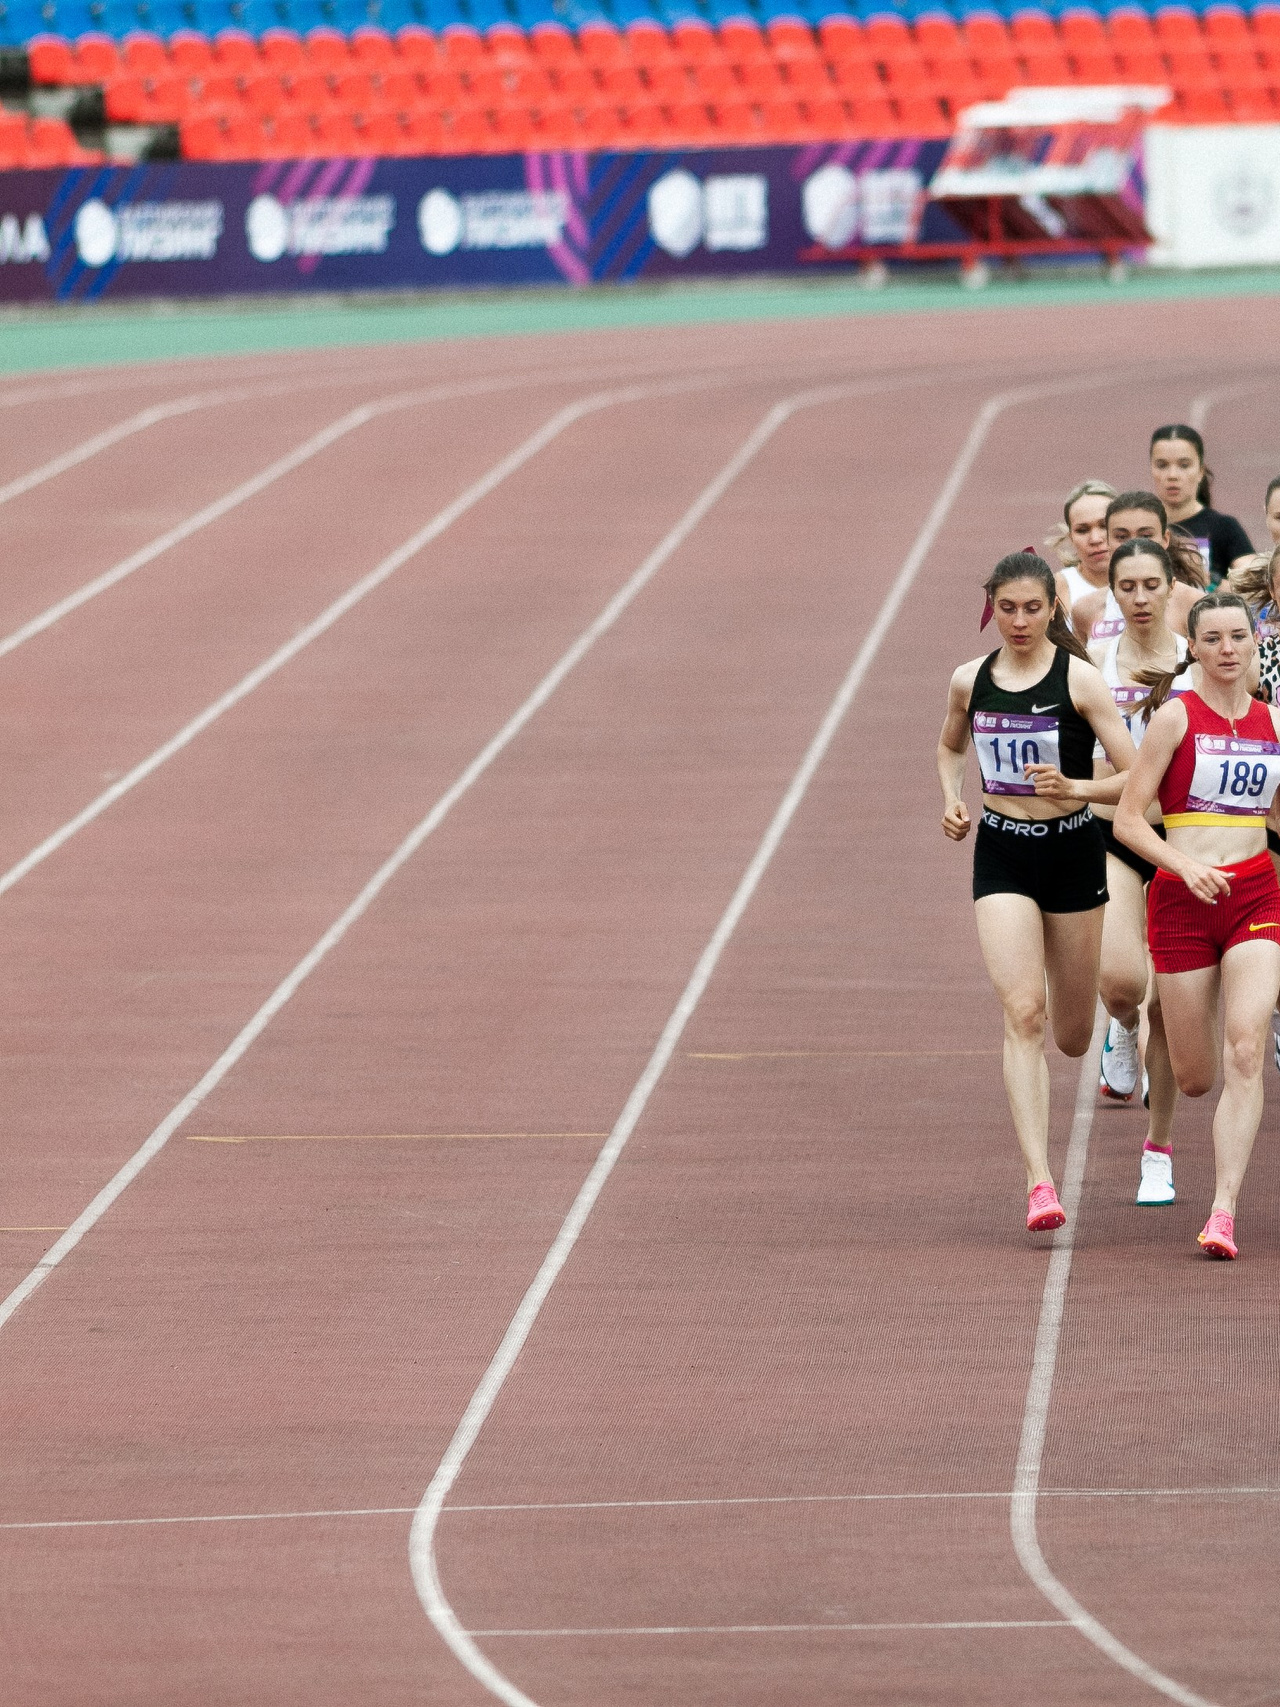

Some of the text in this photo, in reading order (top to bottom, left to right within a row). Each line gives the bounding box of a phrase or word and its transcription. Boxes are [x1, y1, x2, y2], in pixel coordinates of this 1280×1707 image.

[989, 737, 1040, 773] 110
[1218, 759, 1268, 797] 189
[1002, 819, 1049, 837] PRO
